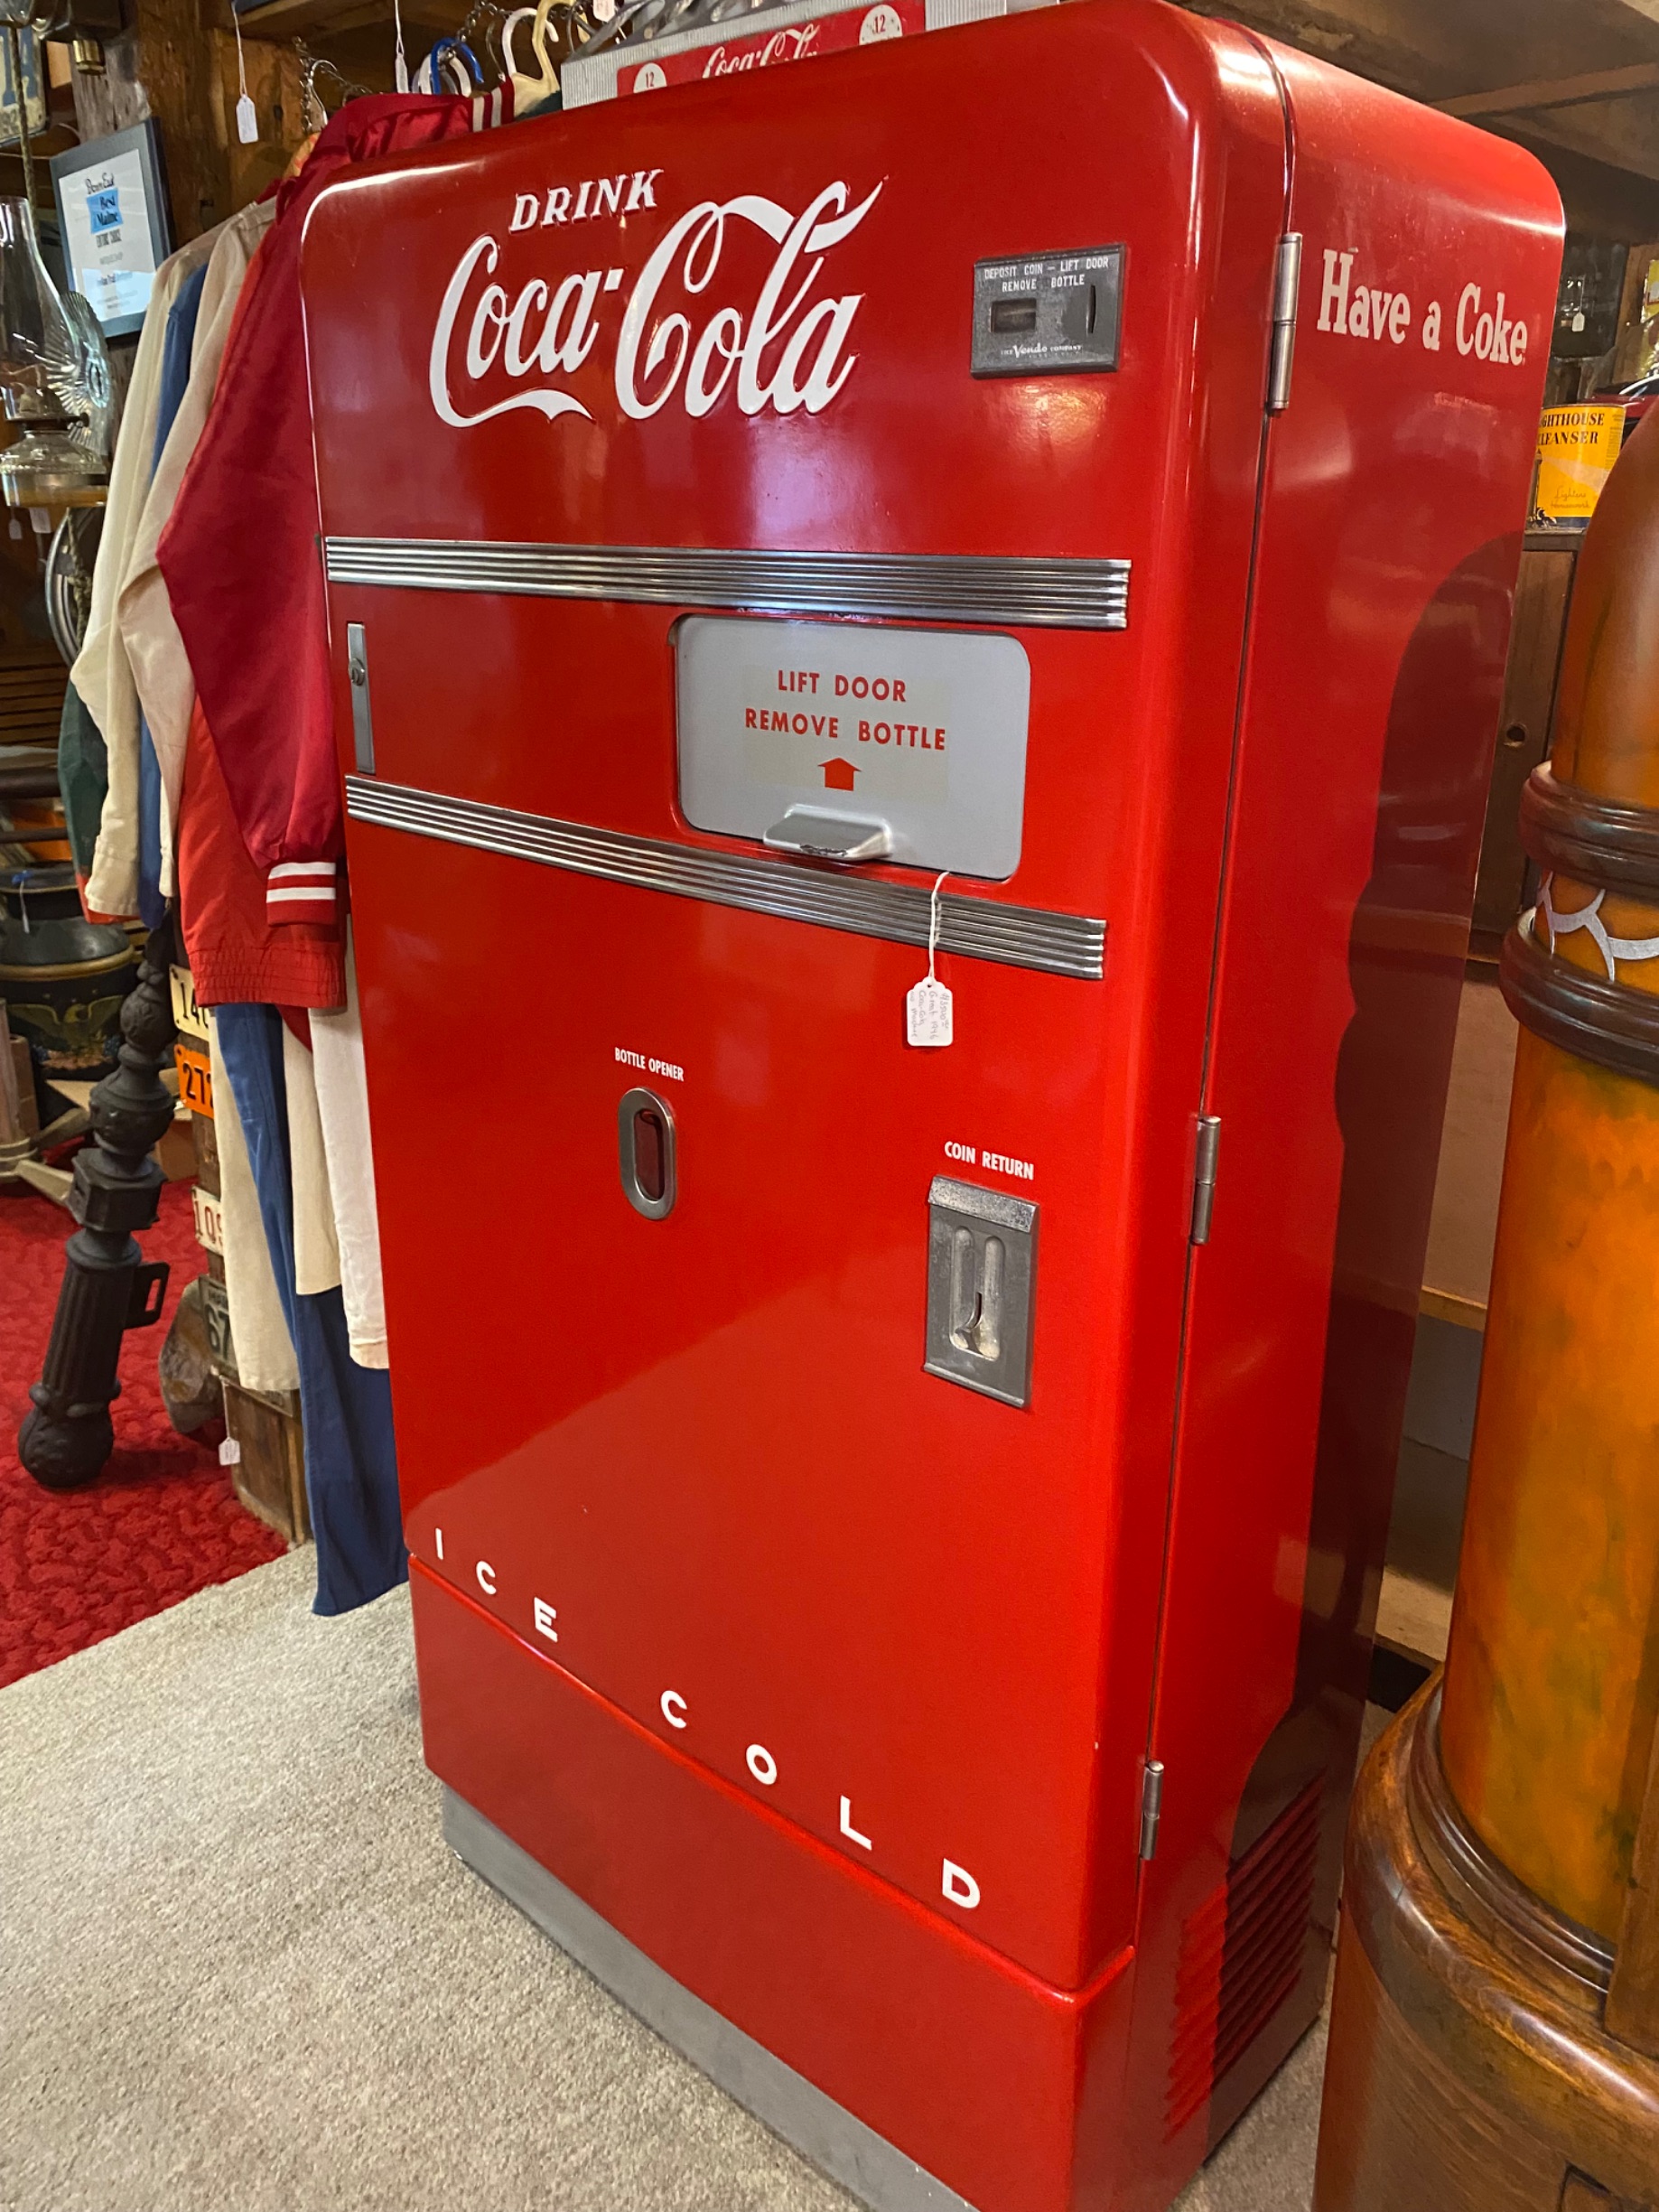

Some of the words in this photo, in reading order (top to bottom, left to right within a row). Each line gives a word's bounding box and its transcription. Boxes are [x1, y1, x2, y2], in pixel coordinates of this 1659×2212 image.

[645, 71, 655, 89] 12
[509, 168, 664, 234] DRINK
[983, 266, 1017, 280] DEPOSIT
[1024, 263, 1043, 276] COIN
[1060, 259, 1079, 272] LIFT
[1086, 256, 1109, 270] DOOR
[1002, 278, 1037, 293] REMOVE
[1050, 274, 1086, 288] BOTTLE
[429, 175, 888, 428] Coca-Cola
[1316, 248, 1411, 345] Have
[1422, 300, 1441, 351] a
[1455, 281, 1528, 367] Coke
[1012, 342, 1048, 359] Vendo
[1541, 412, 1605, 428] GHTHOUSE
[778, 669, 820, 694] LIFT
[834, 674, 907, 703] DOOR
[745, 707, 839, 739] REMOVE
[858, 720, 946, 751] BOTTLE
[614, 1047, 646, 1069] BOTTLE
[648, 1058, 684, 1082] OPENER
[944, 1141, 976, 1165] COIN
[982, 1150, 1034, 1181] RETURN
[435, 1527, 558, 1642] ICE
[660, 1690, 981, 1909] COLD
